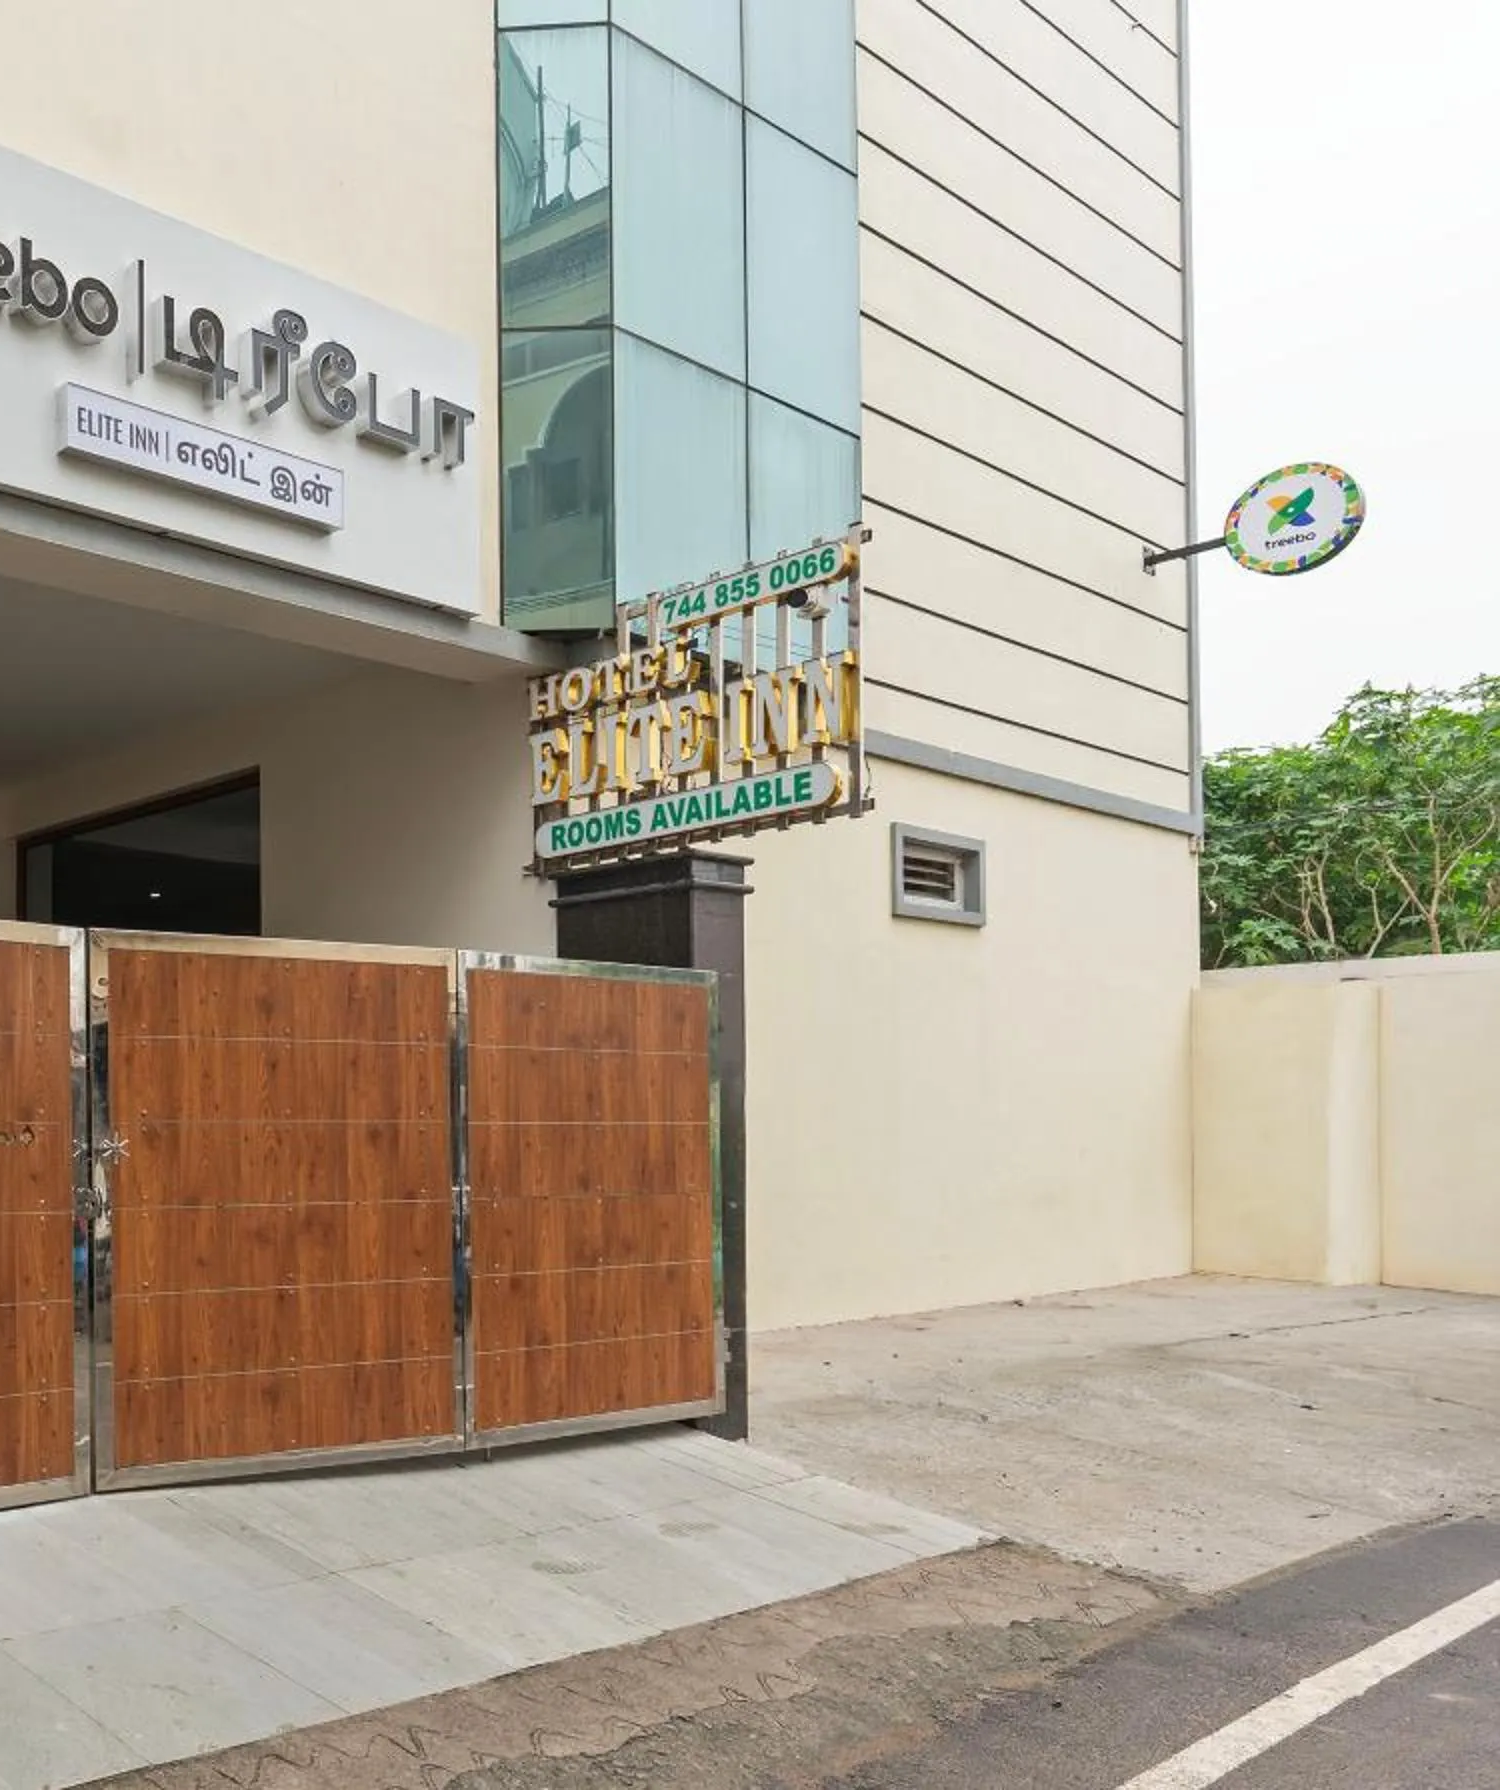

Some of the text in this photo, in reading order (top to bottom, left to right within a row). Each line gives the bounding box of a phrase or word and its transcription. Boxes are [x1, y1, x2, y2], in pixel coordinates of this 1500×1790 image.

[161, 294, 475, 471] டிரீபோ
[76, 405, 160, 457] ELITE INN
[176, 440, 333, 508] எலிட் இன்
[1264, 532, 1316, 550] treebo
[663, 546, 836, 625] 744 855 0066
[528, 639, 696, 721] HOTEL
[530, 654, 856, 806] ELITE INN
[550, 770, 813, 852] ROOMS AVAILABLE
